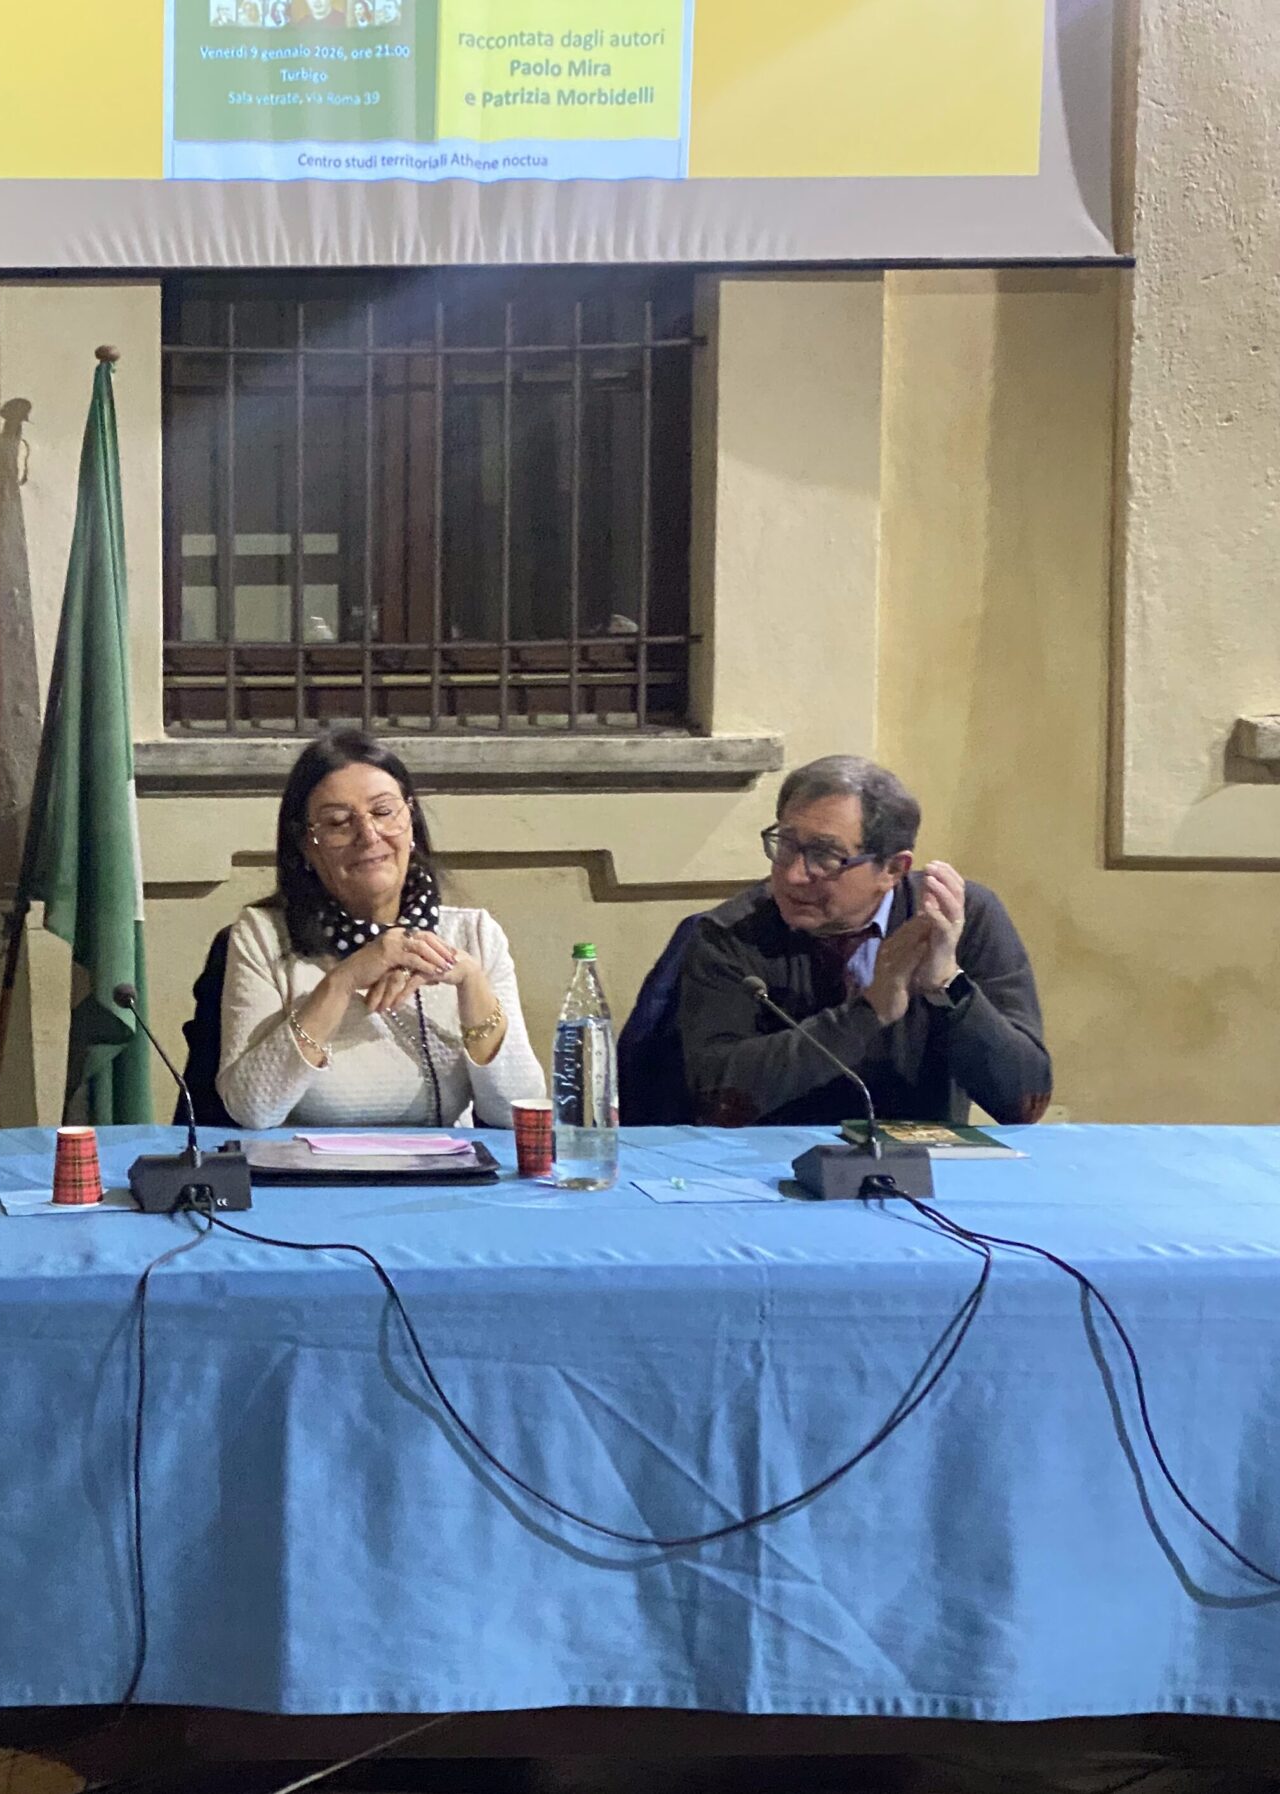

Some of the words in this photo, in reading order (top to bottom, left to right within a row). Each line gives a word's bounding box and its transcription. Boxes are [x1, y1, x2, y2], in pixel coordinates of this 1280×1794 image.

[458, 30, 554, 50] raccontata
[560, 29, 604, 51] dagli
[609, 28, 666, 48] autori
[250, 47, 258, 58] 9
[261, 46, 311, 62] gennaio
[314, 46, 348, 60] 2026,
[351, 49, 372, 59] ore
[280, 68, 329, 83] Turbigo
[510, 59, 562, 76] Paolo
[568, 59, 612, 77] Mira
[228, 91, 253, 104] Sala
[326, 93, 361, 105] Roma
[363, 91, 381, 104] 39
[464, 92, 476, 105] e
[482, 88, 551, 108] Patrizia
[557, 86, 655, 105] Morbidelli
[298, 153, 342, 168] Centro
[345, 154, 377, 169] studi
[381, 153, 448, 170] territoriali
[450, 152, 499, 170] Athene
[502, 154, 549, 168] noctua
